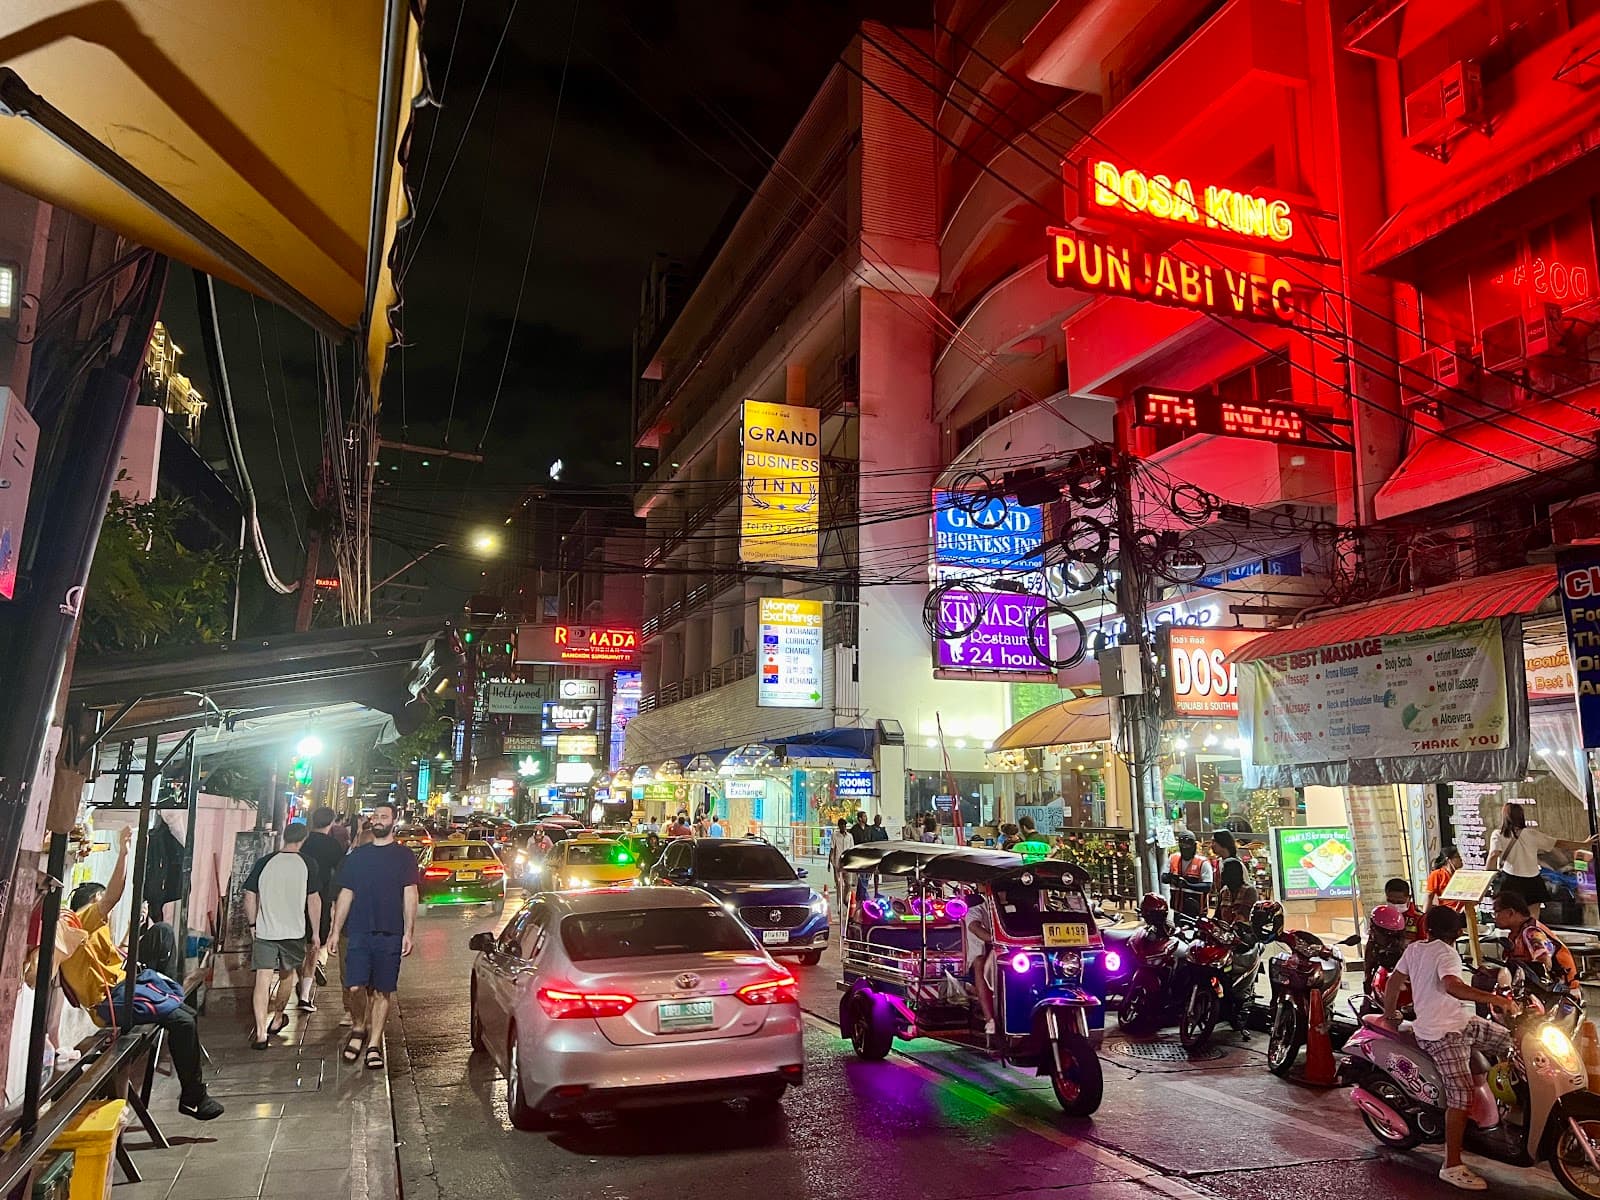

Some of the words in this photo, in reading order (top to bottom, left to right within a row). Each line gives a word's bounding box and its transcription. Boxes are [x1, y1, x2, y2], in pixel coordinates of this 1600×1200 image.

[1094, 161, 1199, 223] DOSA
[1205, 185, 1293, 241] KING
[748, 426, 817, 447] GRAND
[746, 453, 819, 473] BUSINESS
[762, 479, 802, 495] INN
[946, 507, 1031, 532] GRAND
[937, 531, 1011, 554] BUSINESS
[762, 600, 800, 613] Money
[762, 611, 821, 625] Exchange
[1154, 606, 1212, 627] Shop
[785, 628, 819, 636] EXCHANGE
[785, 637, 819, 646] CURRENCY
[971, 631, 1046, 648] Restaurnt
[785, 646, 810, 655] CHANGE
[969, 647, 994, 665] 24
[1290, 650, 1318, 669] BEST
[1320, 638, 1383, 665] MASSAGE
[1433, 649, 1451, 663] Lotion
[1451, 646, 1478, 660] Massage
[1384, 657, 1397, 672] Body
[1397, 655, 1413, 668] Scrub
[1339, 665, 1359, 679] Massage
[1285, 673, 1310, 687] Massage
[1436, 681, 1448, 694] Hot
[1455, 676, 1479, 692] Massage
[1535, 674, 1563, 690] Best
[492, 685, 542, 704] Hollywood
[1177, 701, 1203, 711] PUNJABI
[1210, 702, 1231, 711] SOUTH
[1285, 701, 1311, 716] Massage
[1327, 700, 1339, 710] Neck
[1340, 699, 1348, 709] and
[1349, 696, 1372, 708] Shoulder
[1440, 712, 1472, 726] Aloevera
[1351, 723, 1371, 737] Massage
[1411, 737, 1460, 753] THANK
[1468, 734, 1500, 746] YOU
[730, 782, 751, 790] Money
[839, 778, 871, 787] ROOMS
[730, 788, 763, 797] Exchange
[1016, 808, 1044, 822] GRAND
[1311, 831, 1319, 840] for
[1319, 831, 1333, 840] more
[1333, 830, 1346, 840] than
[1065, 926, 1086, 937] 4199
